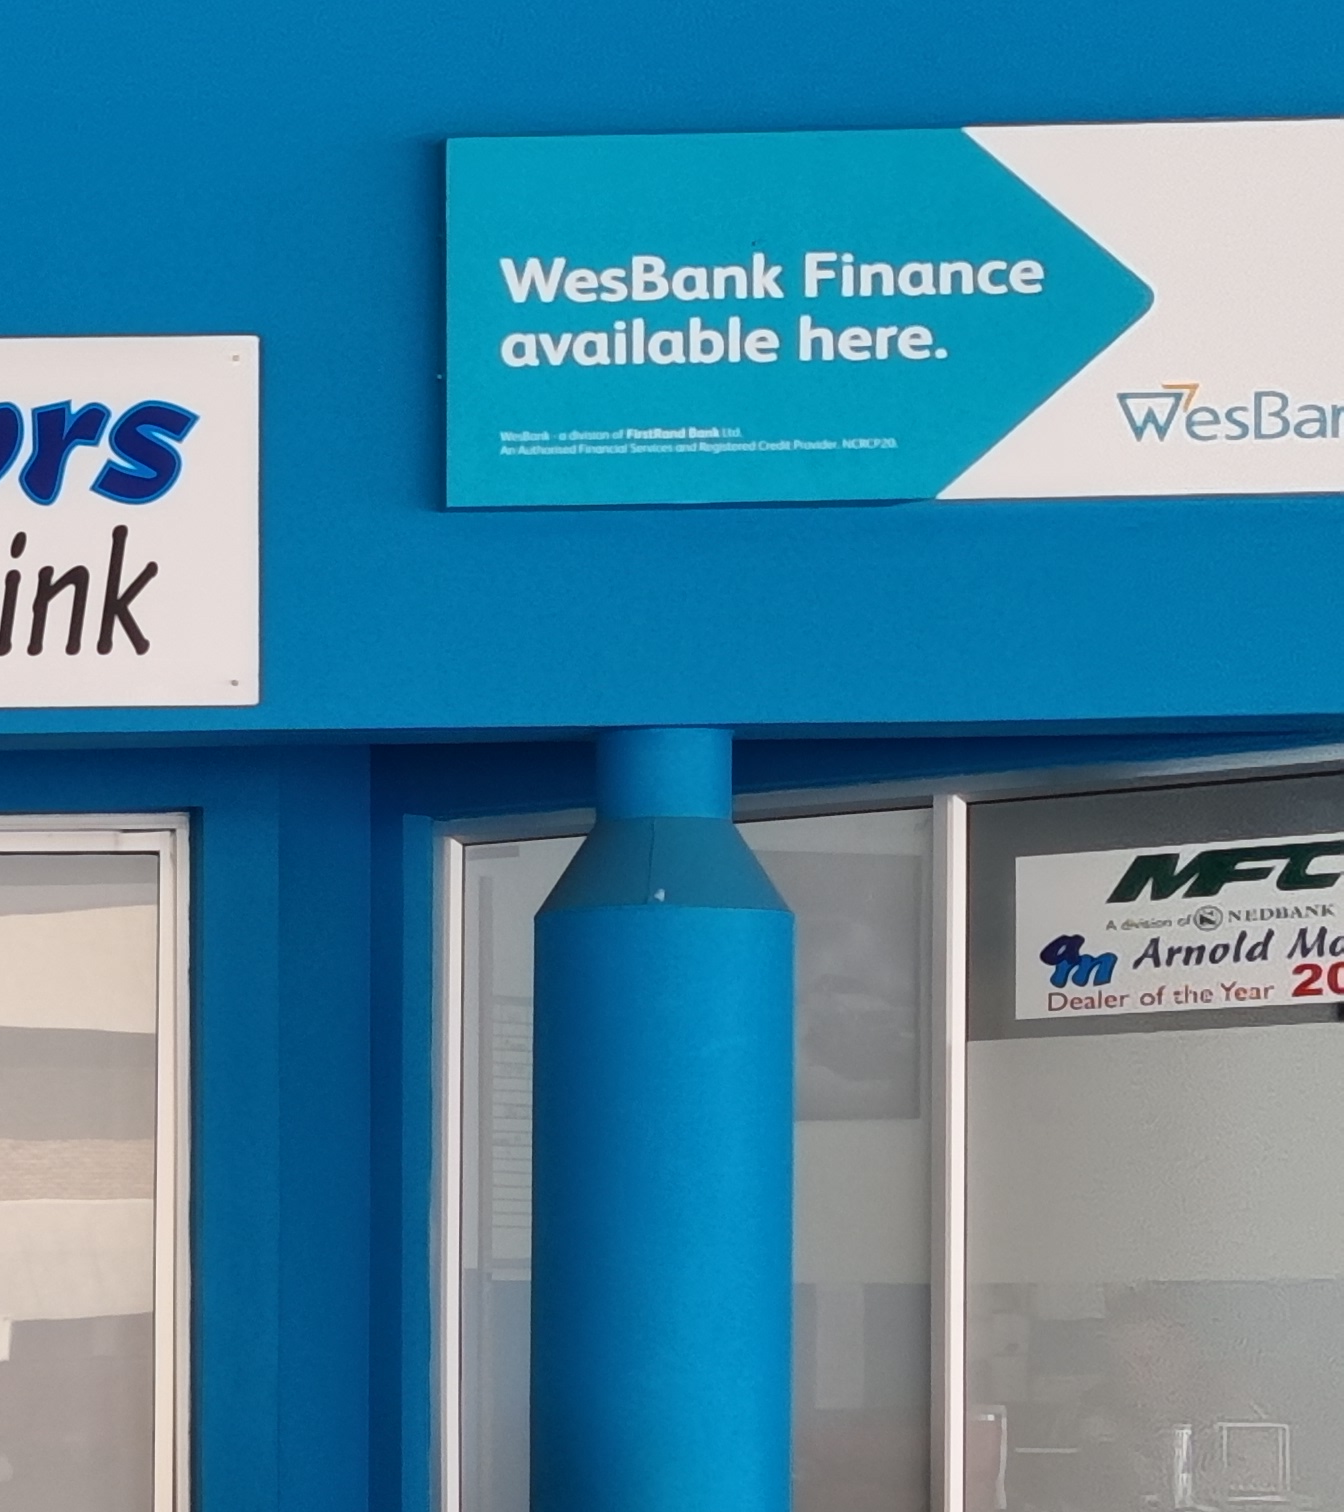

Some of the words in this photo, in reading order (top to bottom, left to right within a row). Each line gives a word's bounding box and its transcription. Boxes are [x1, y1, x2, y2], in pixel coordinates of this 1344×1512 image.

[499, 253, 784, 303] WesBank
[804, 249, 1045, 298] Finance
[500, 317, 779, 368] available
[799, 315, 948, 362] here.
[499, 431, 550, 442] WesBank
[568, 430, 610, 441] division
[612, 430, 624, 440] of
[626, 428, 686, 440] FirstRand
[688, 427, 720, 439] Bank
[578, 444, 628, 454] Financial
[698, 440, 756, 454] Registered
[758, 440, 791, 450] Credit
[1106, 840, 1344, 903] MFC
[1105, 920, 1118, 931] A
[1120, 918, 1173, 931] division
[1177, 914, 1192, 927] of
[1228, 904, 1336, 923] NEDBANK
[1132, 928, 1276, 970] Arnold
[1047, 990, 1130, 1012] Dealer
[1140, 985, 1167, 1006] of
[1174, 984, 1214, 1005] the
[1220, 981, 1275, 1002] Year
